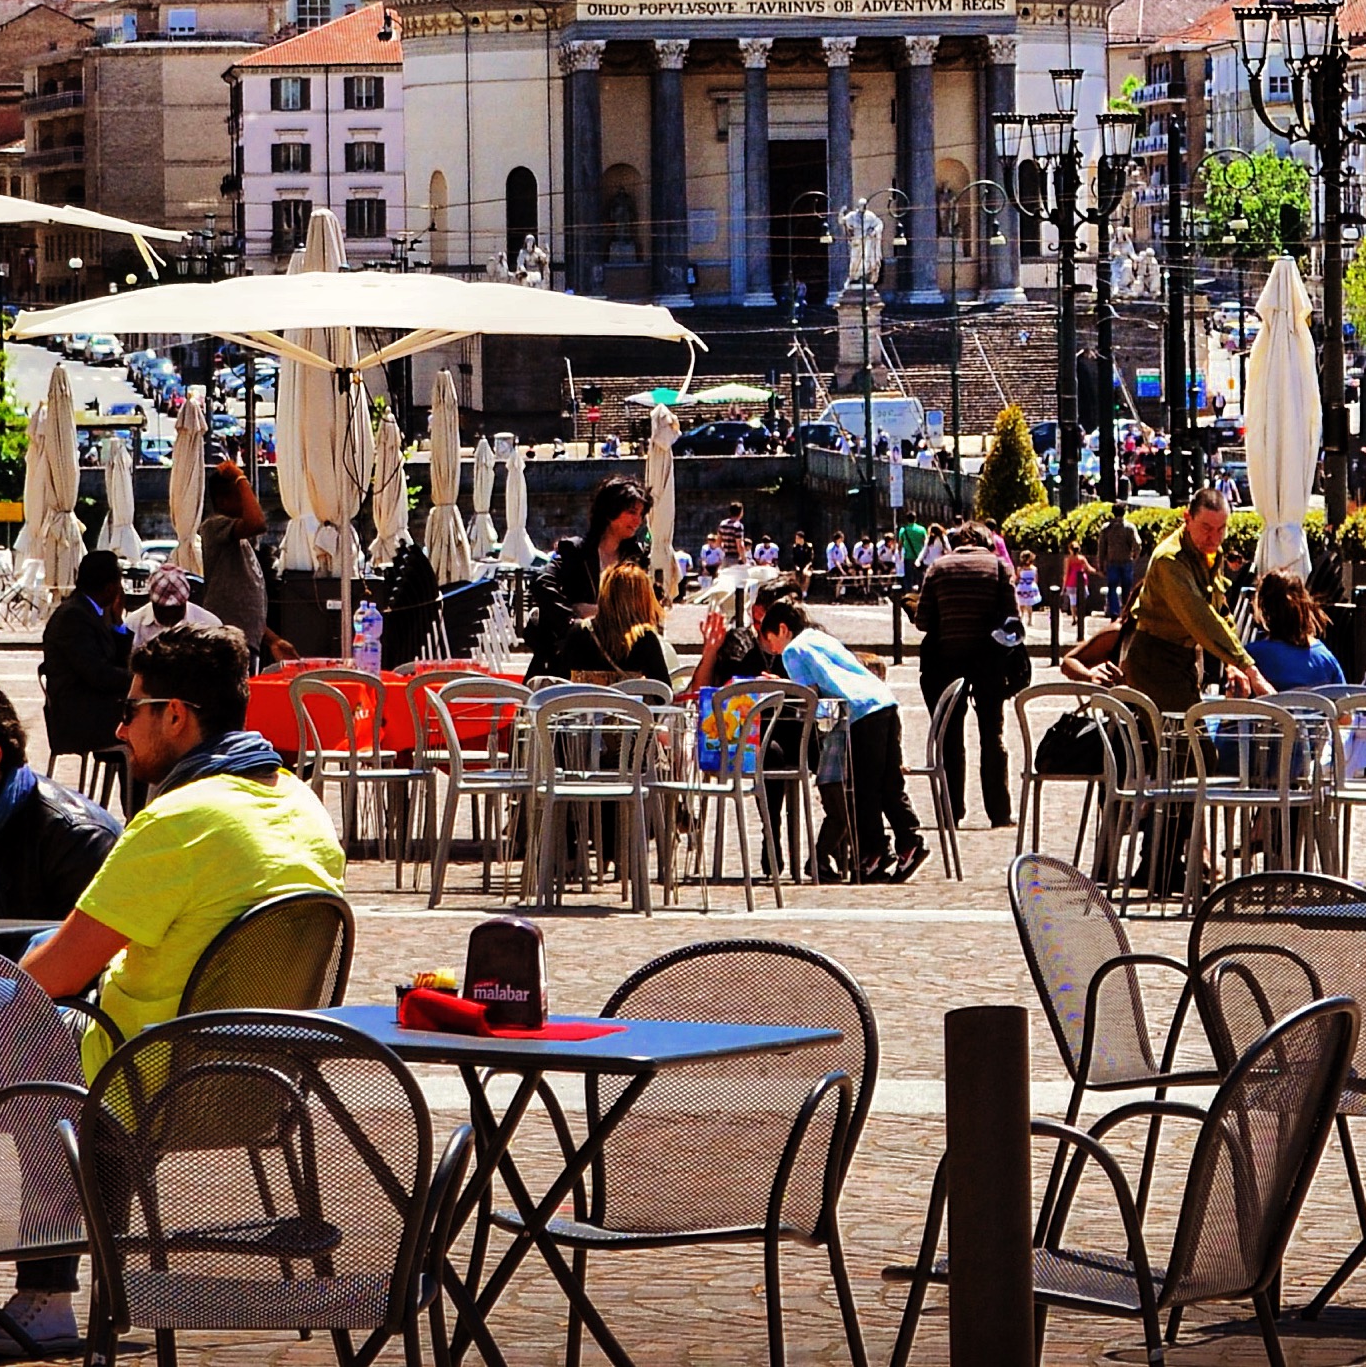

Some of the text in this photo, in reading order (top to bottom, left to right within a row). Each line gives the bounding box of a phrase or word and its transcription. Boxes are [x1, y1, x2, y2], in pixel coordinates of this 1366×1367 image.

[587, 2, 629, 16] ORDO
[638, 1, 737, 17] POPVLVSQVE
[747, 0, 825, 15] TAVRINVS
[834, 0, 853, 14] OB
[862, 0, 952, 14] ADVENTVM
[473, 983, 530, 1002] malabar
